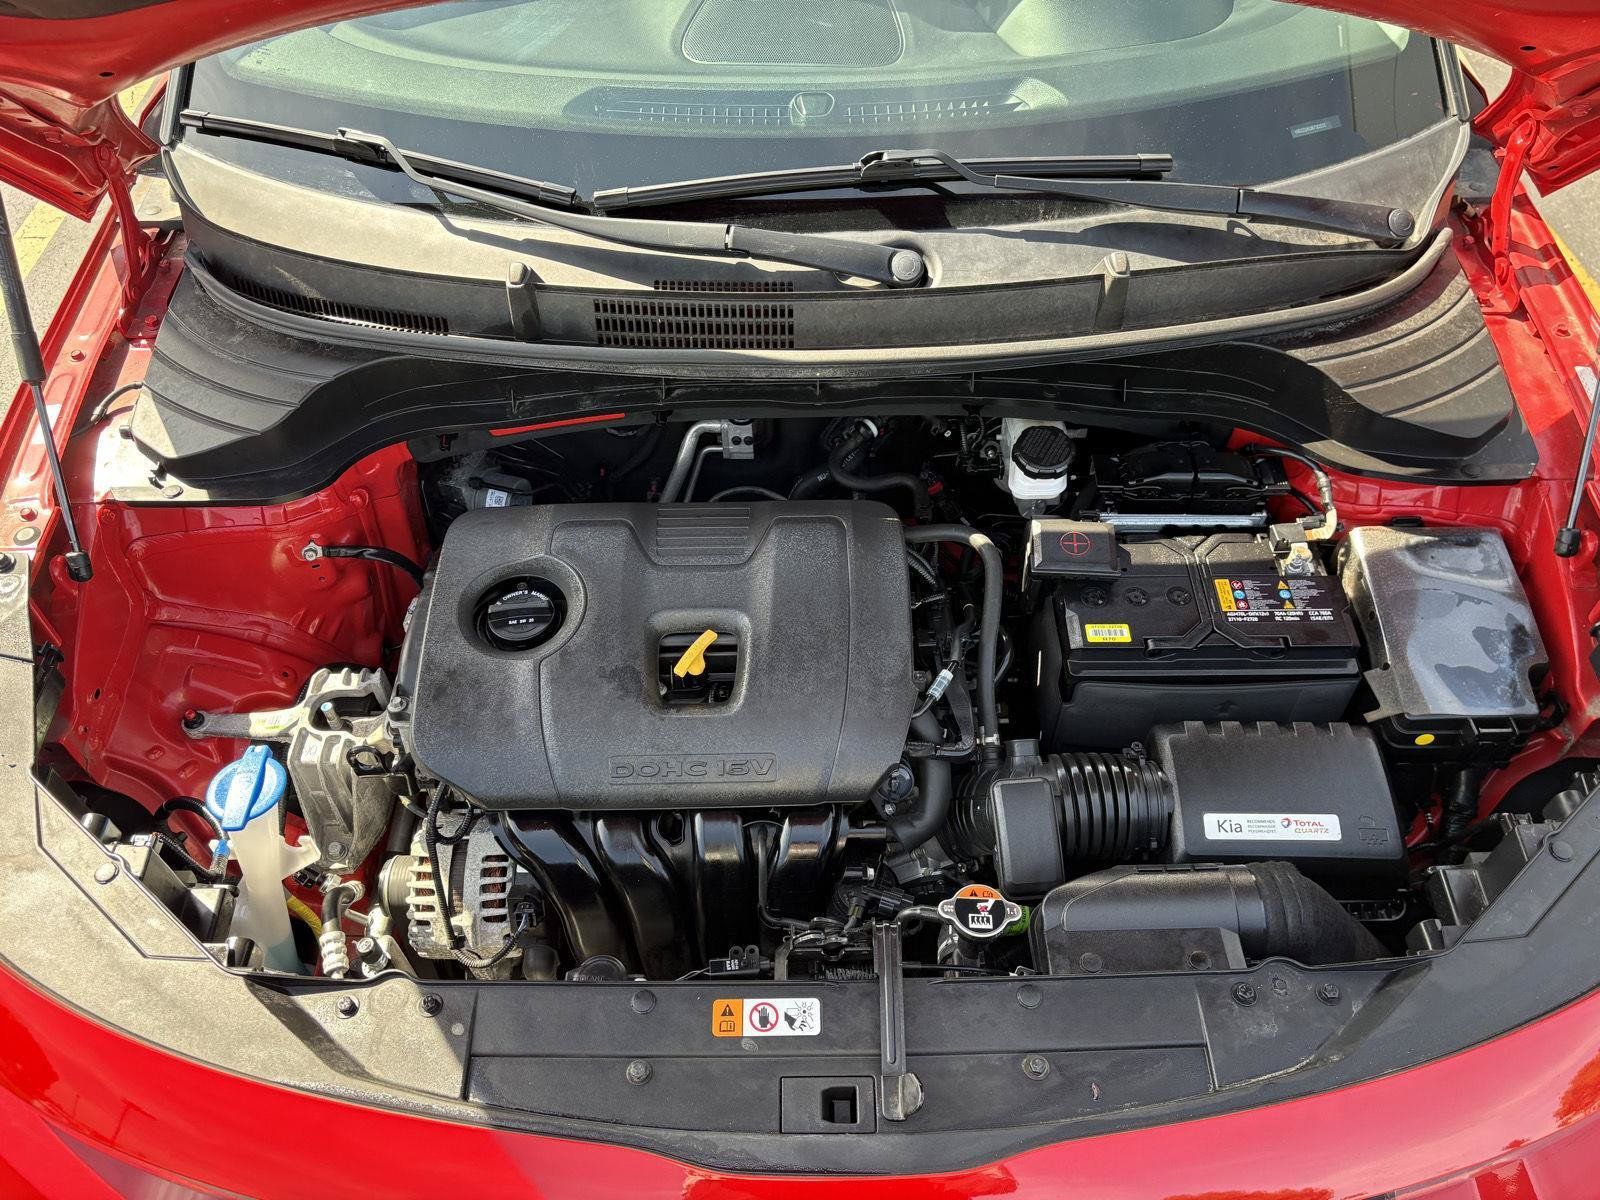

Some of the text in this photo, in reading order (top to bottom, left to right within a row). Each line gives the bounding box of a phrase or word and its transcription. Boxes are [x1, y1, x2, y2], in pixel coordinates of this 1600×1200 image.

[503, 590, 528, 601] OWNER'S
[611, 758, 774, 778] DOHC 16V
[1217, 819, 1243, 833] Kia
[1293, 819, 1324, 827] TOTAL
